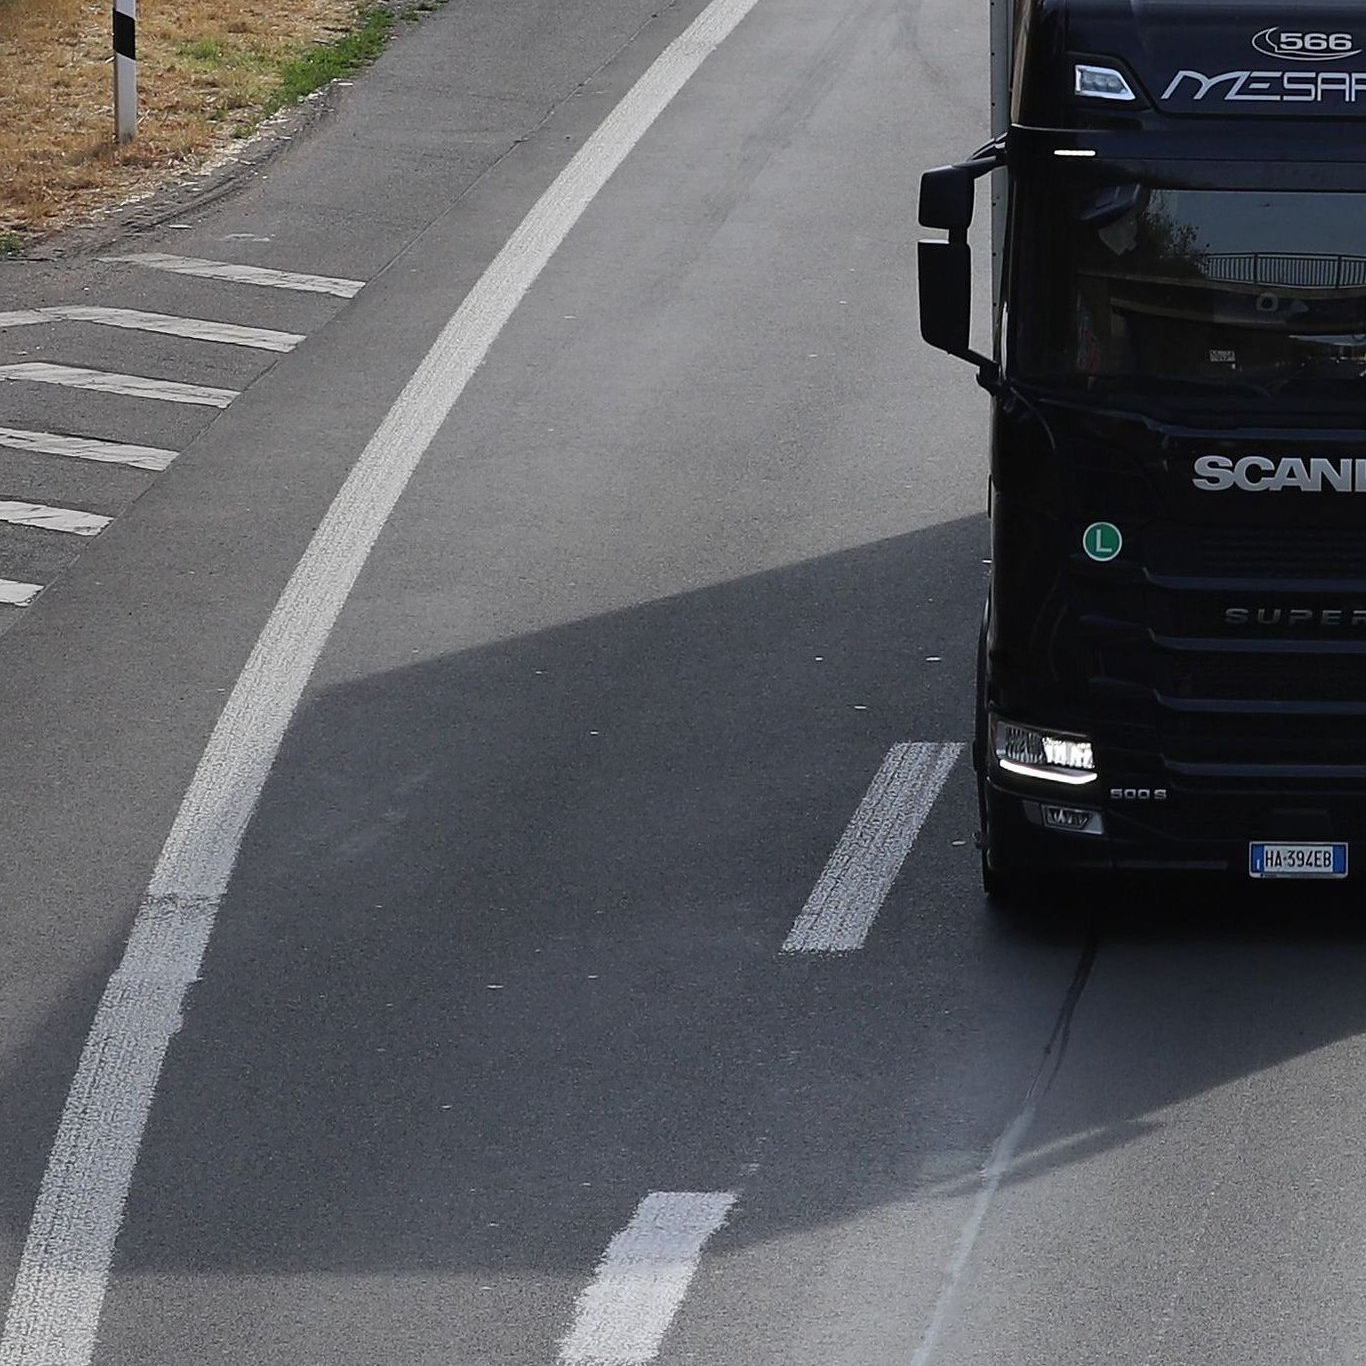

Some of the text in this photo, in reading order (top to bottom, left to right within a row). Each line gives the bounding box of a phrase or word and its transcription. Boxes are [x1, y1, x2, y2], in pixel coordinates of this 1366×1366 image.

[1280, 33, 1353, 51] 566
[1096, 529, 1113, 553] L
[1110, 788, 1168, 799] 500 S
